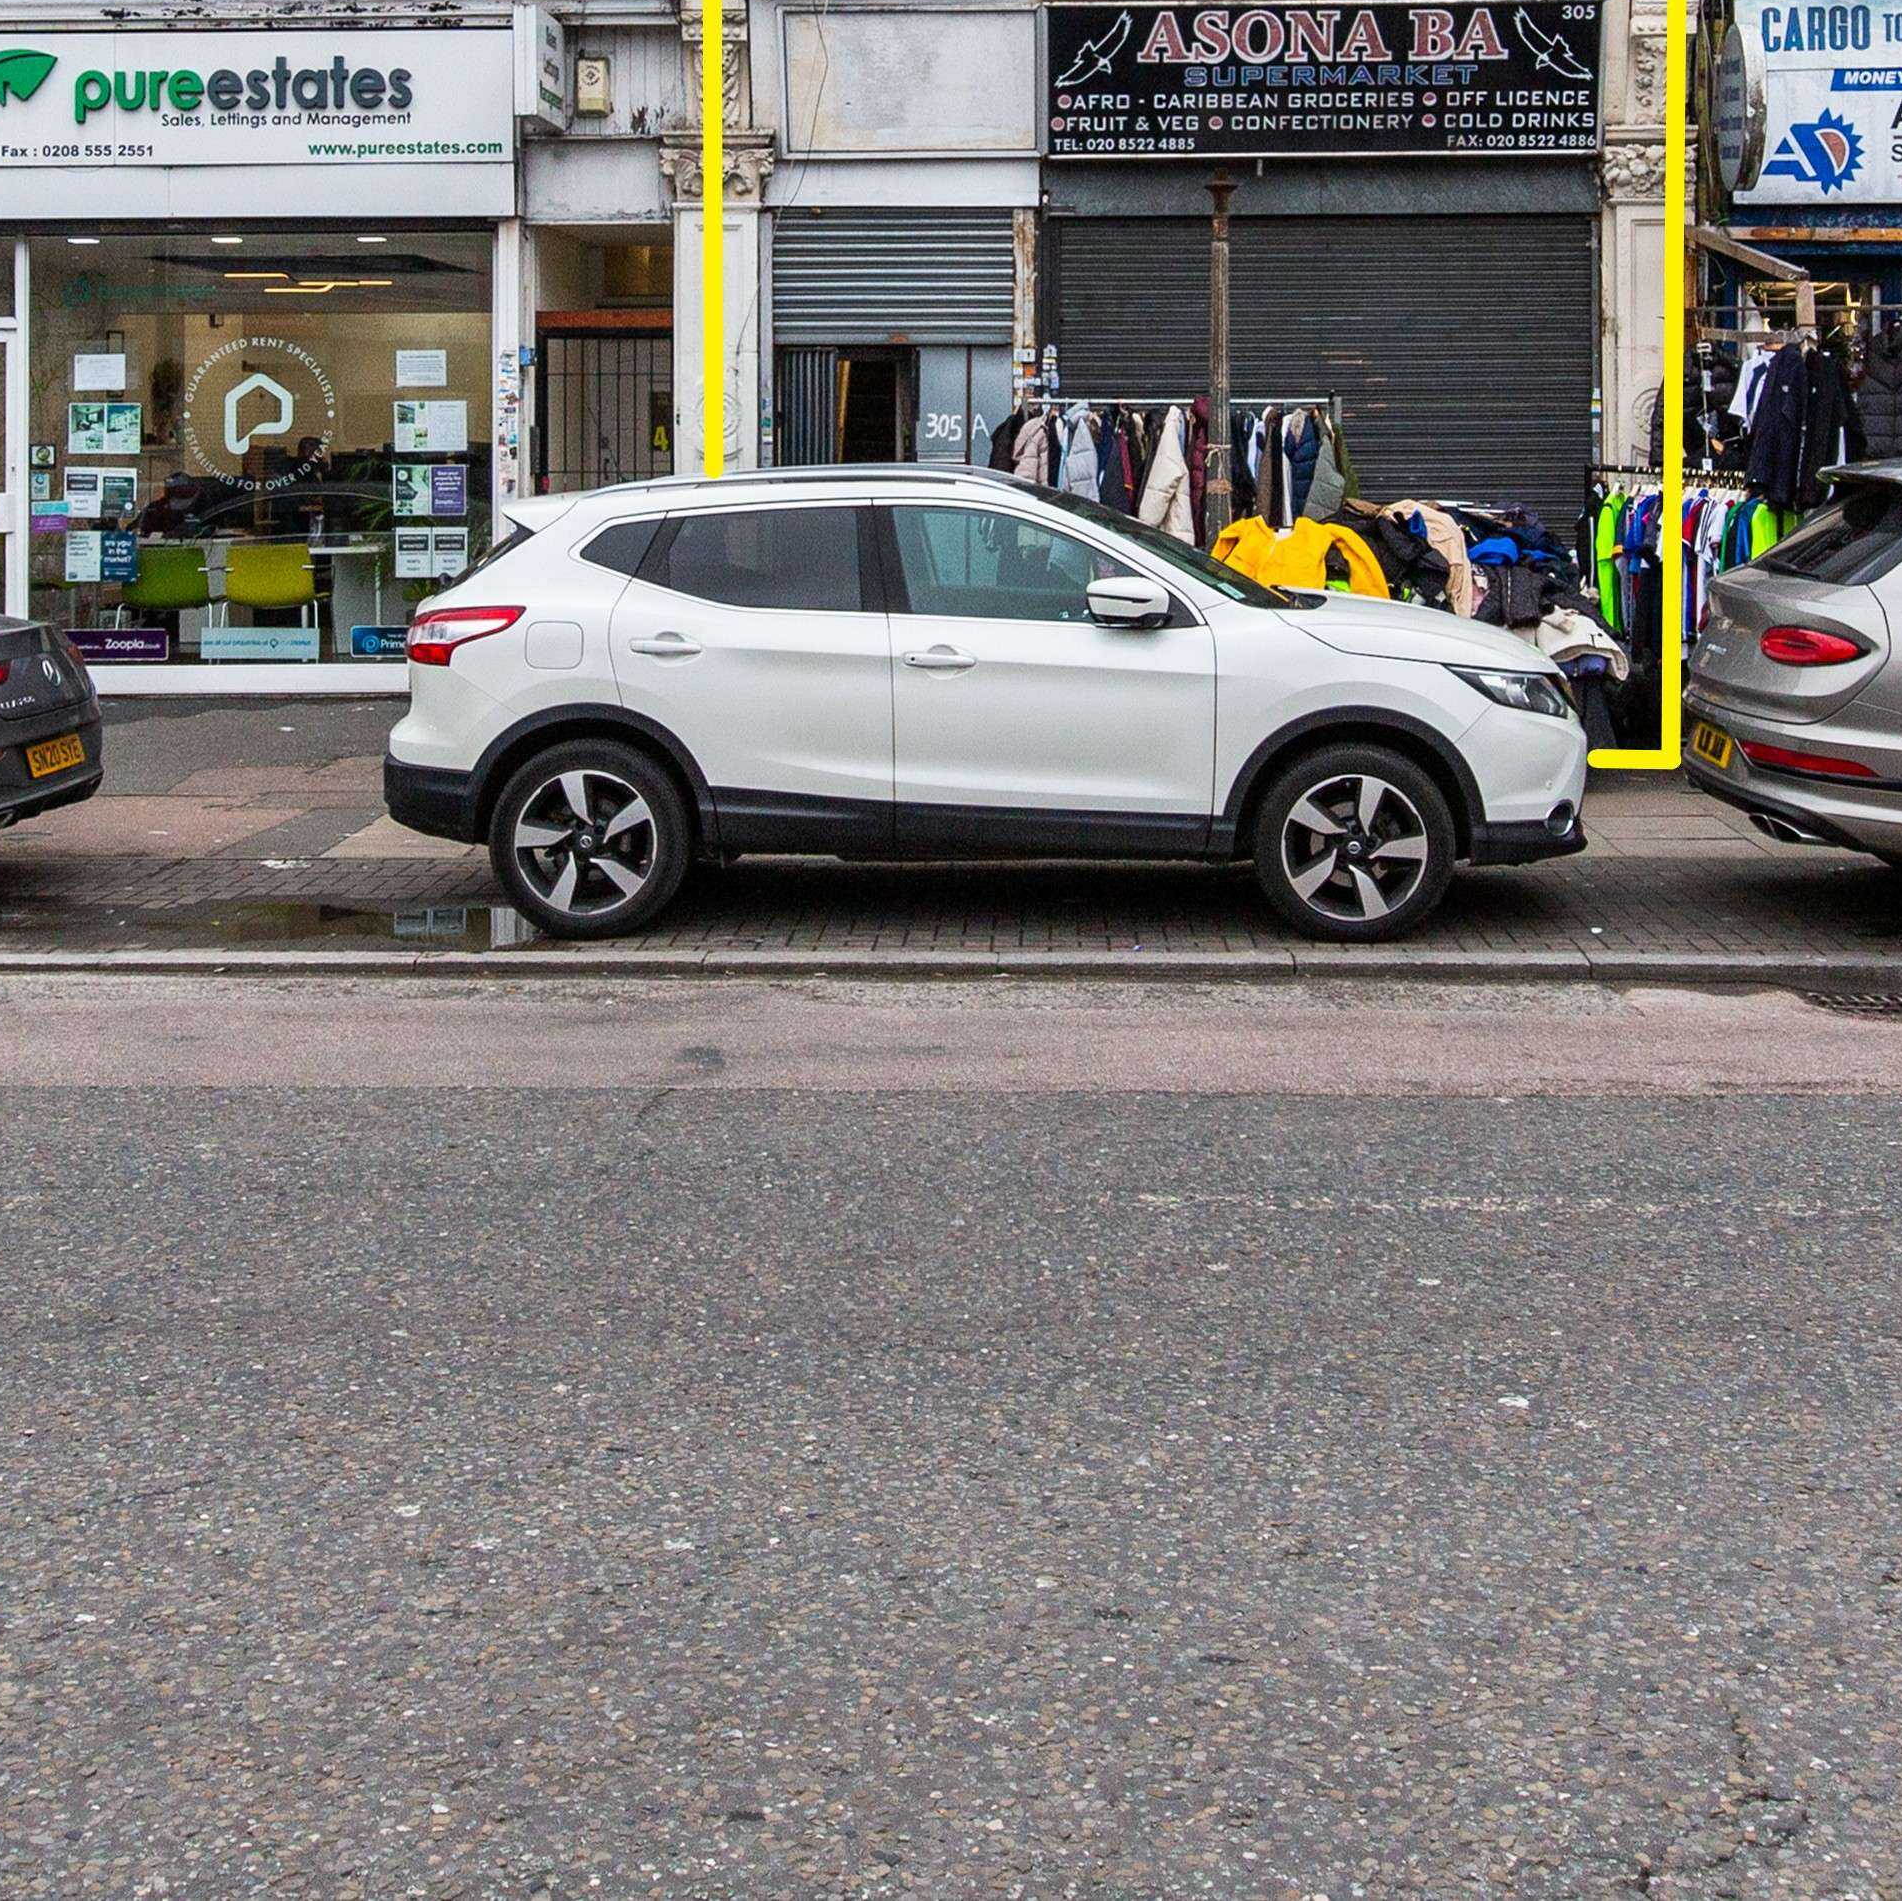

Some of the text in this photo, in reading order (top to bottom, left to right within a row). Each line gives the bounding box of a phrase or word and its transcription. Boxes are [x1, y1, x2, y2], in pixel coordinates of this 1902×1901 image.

[1562, 5, 1596, 19] 305
[1137, 8, 1509, 64] ASONA BA
[1761, 4, 1871, 52] CARGO
[1183, 64, 1479, 87] SUPERMARKET
[74, 55, 413, 124] pureestates
[1073, 90, 1590, 109] AFRO CARIBBEAN GROCERIES OFF LICENCE
[161, 111, 412, 129] Sales, Lettings and Management
[1066, 112, 1596, 131] FRUIT & VEG CONFECTIONERY COLD DRINKS
[308, 141, 503, 158] www.pureestates.com
[1054, 136, 1196, 151] TEL: 020 8522 4885
[1447, 134, 1596, 148] FAX: 020 8522 4886
[41, 144, 80, 158] 0208
[84, 144, 113, 157] 555
[117, 144, 154, 157] 2551
[184, 337, 248, 403] GUARANTEED
[251, 336, 285, 349] RENT
[286, 342, 336, 406] SPECIALISTS
[925, 412, 963, 442] 305
[265, 473, 298, 491] OVER
[297, 462, 312, 477] 10
[310, 429, 334, 464] YEARS
